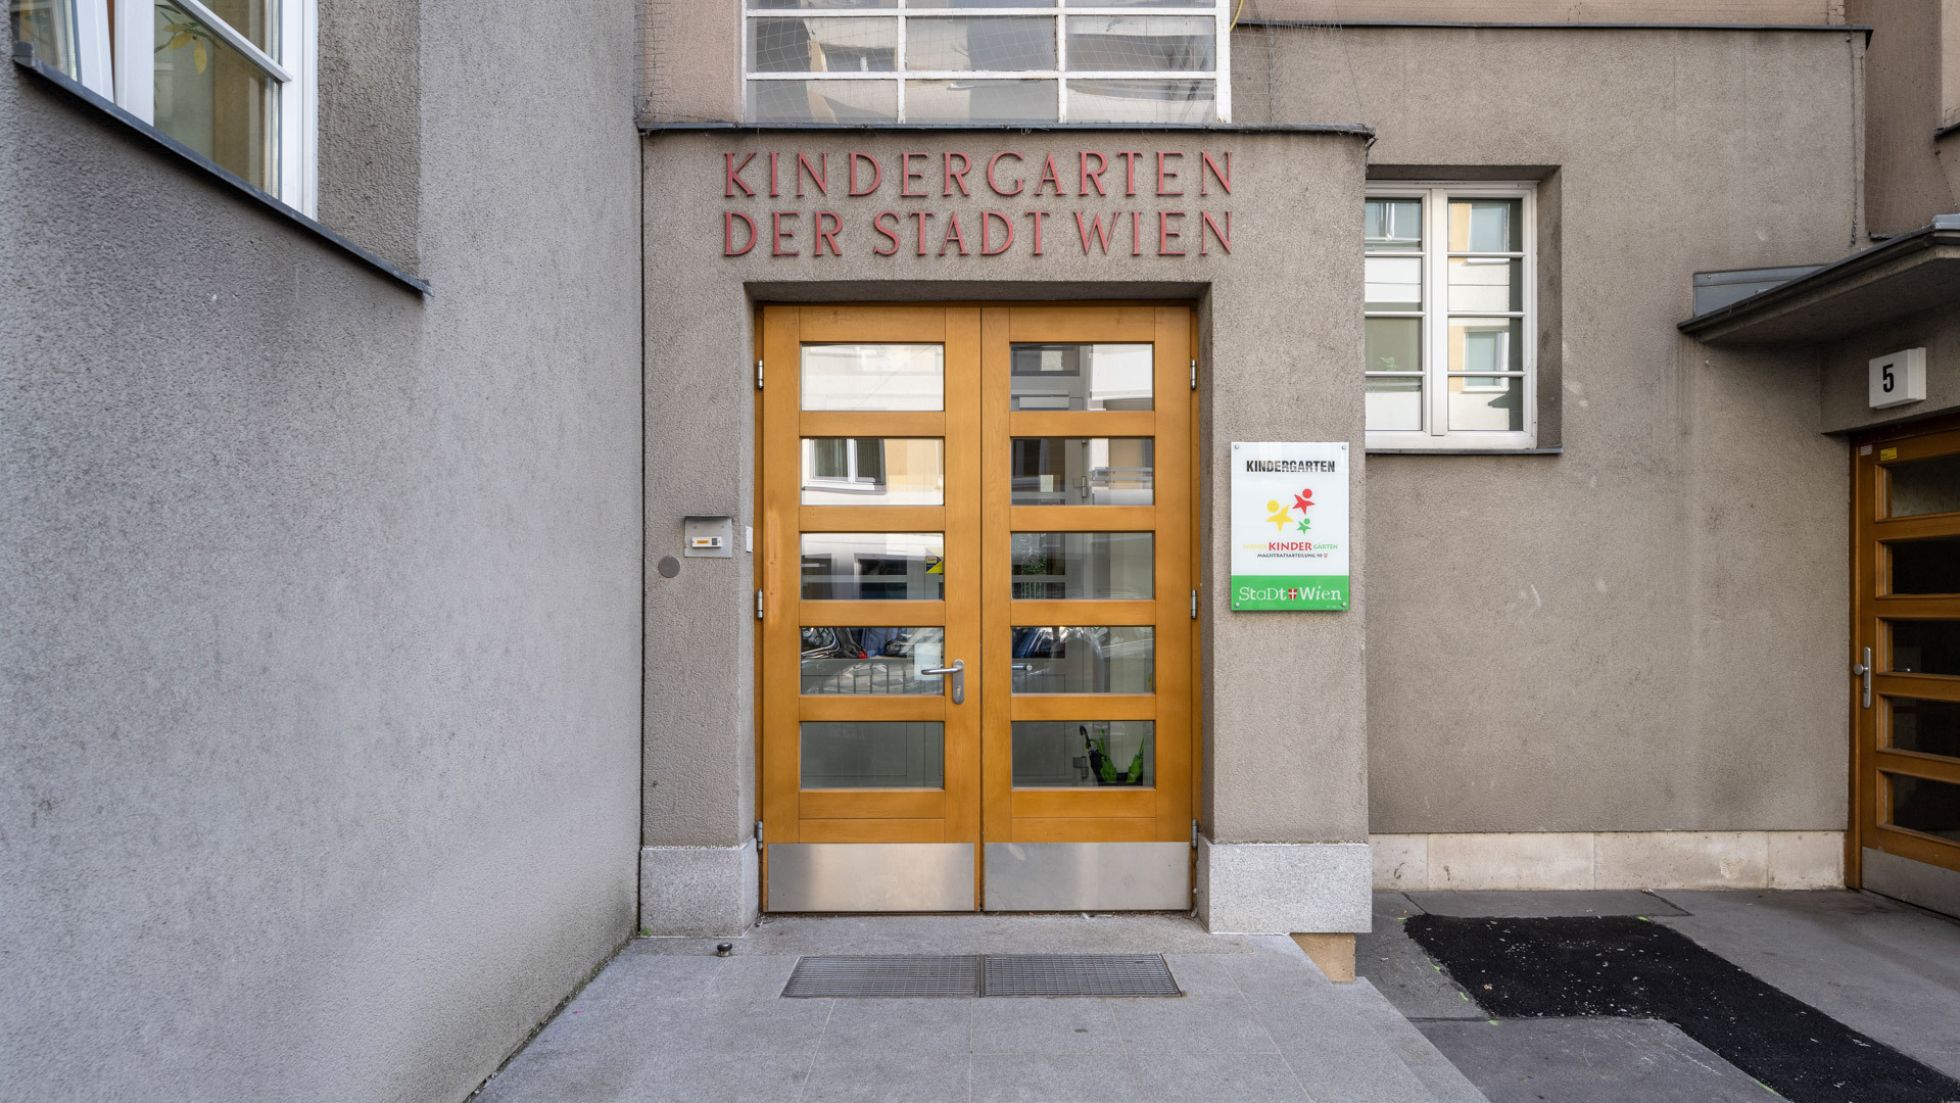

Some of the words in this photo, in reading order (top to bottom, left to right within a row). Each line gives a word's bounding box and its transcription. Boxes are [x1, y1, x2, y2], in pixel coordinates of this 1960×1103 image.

[724, 151, 1233, 197] KINDERGARTEN
[724, 211, 844, 257] DER
[873, 211, 1051, 257] STADT
[1073, 211, 1233, 257] WIEN
[1883, 363, 1894, 392] 5
[1246, 460, 1335, 472] KINDERGARTEN
[1268, 542, 1313, 551] KINDER
[1299, 586, 1342, 601] Wien
